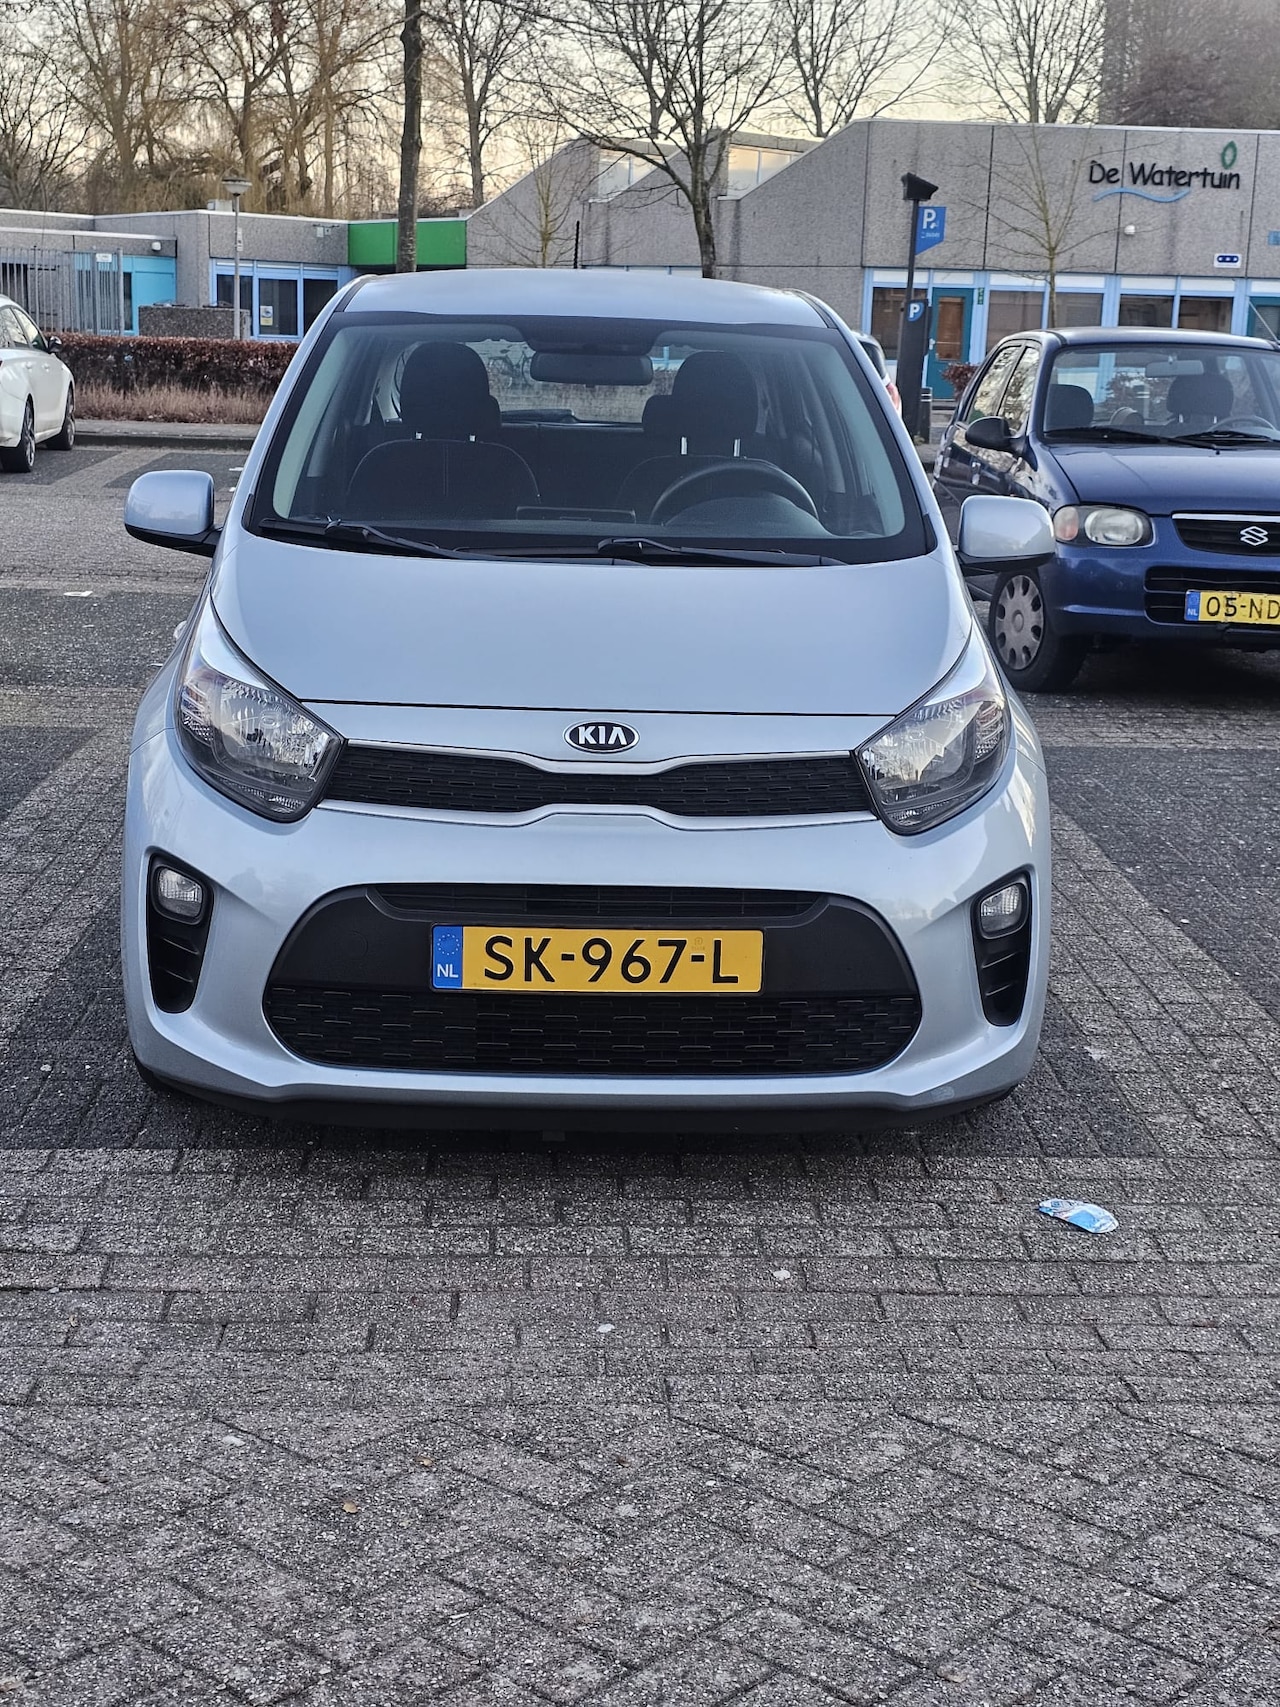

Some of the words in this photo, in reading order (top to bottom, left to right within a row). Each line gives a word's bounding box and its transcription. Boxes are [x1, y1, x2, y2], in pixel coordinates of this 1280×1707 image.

[1088, 160, 1120, 185] De
[1129, 161, 1240, 190] Watertuin
[922, 208, 937, 230] P
[909, 303, 921, 319] P
[1187, 608, 1198, 617] NL
[1206, 596, 1280, 620] 05-ND
[578, 725, 628, 746] KIA
[484, 935, 739, 984] SK-967-L
[436, 963, 459, 979] NL
